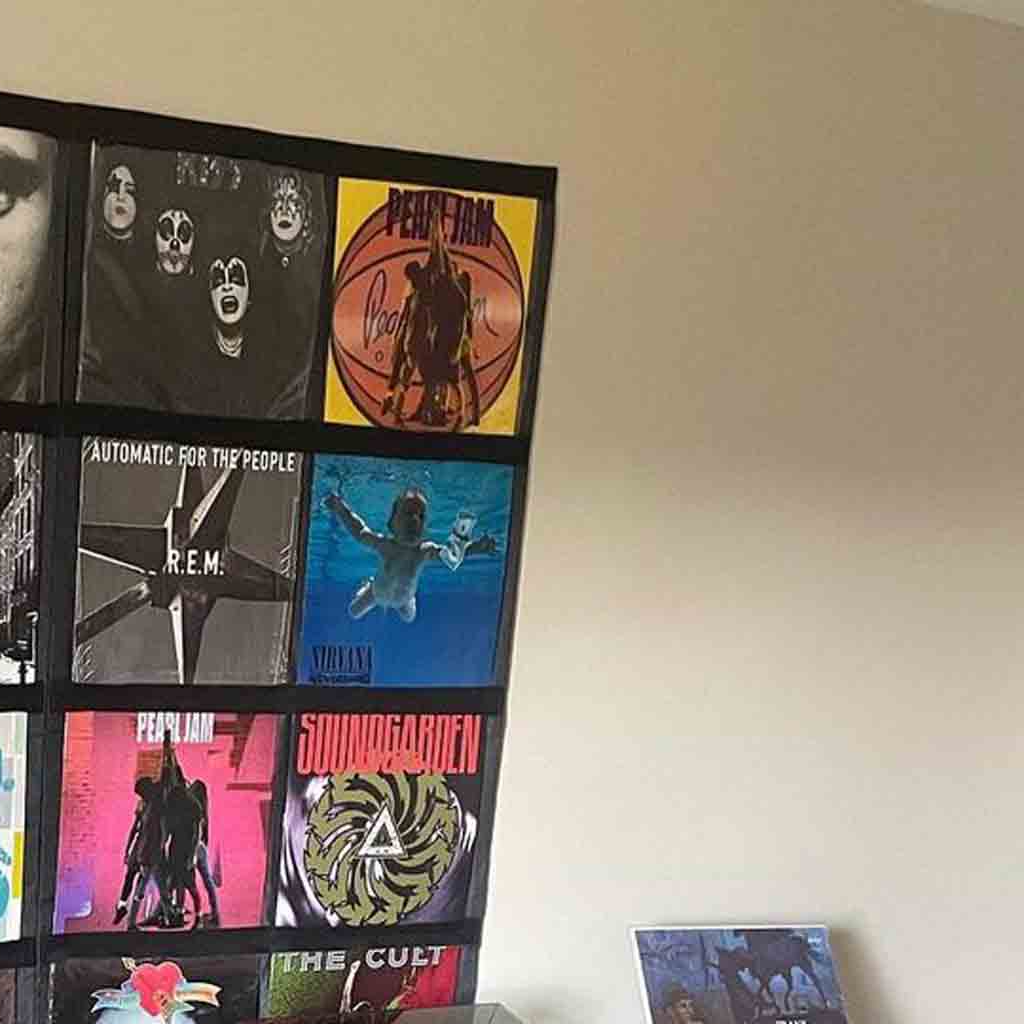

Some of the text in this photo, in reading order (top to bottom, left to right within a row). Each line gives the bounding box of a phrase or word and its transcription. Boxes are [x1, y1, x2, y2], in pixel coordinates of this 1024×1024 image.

[91, 440, 296, 472] AUTOMATIC FOR THE PEOPLE
[167, 549, 225, 576] R.E.M.
[136, 711, 215, 743] PEARL JAM
[296, 712, 481, 776] SOUNDGARDEN
[276, 945, 447, 973] THE CULT
